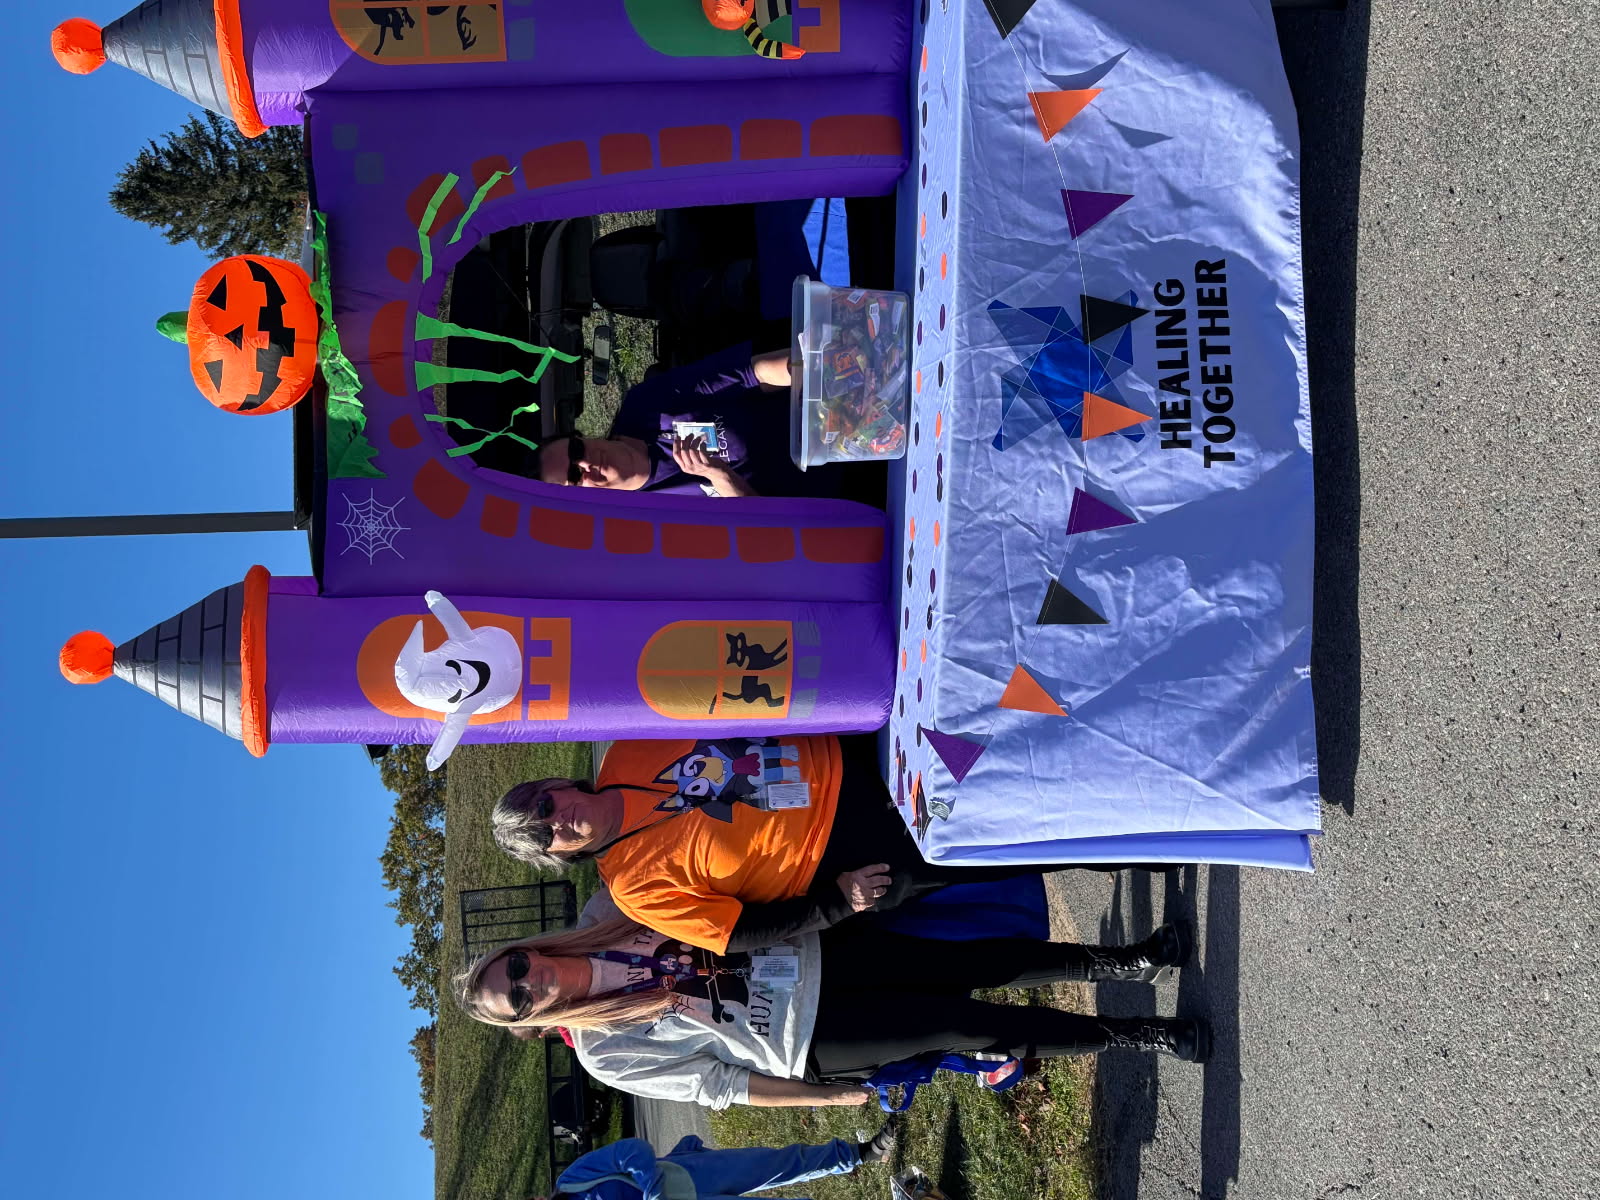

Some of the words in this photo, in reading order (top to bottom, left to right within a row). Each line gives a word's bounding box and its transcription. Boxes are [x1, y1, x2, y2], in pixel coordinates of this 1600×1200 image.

[713, 414, 731, 463] EGANY
[1154, 279, 1192, 450] HEALING
[1194, 258, 1236, 469] TOGETHER
